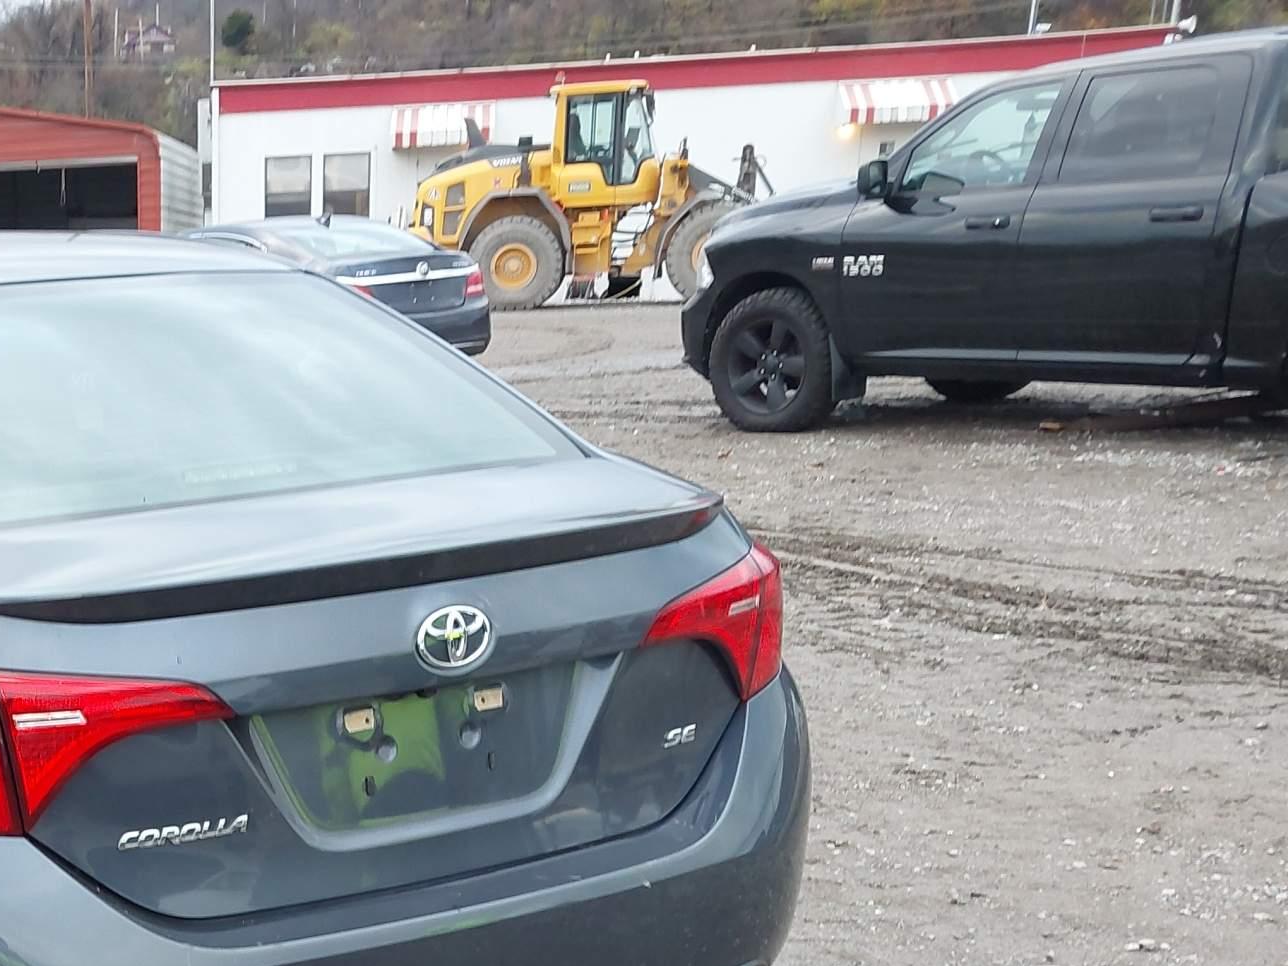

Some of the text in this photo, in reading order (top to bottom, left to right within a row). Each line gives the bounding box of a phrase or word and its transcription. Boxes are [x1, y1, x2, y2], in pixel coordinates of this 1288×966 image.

[842, 264, 884, 277] 1500
[843, 255, 885, 267] RAM
[663, 723, 697, 749] SE
[117, 814, 249, 850] COROLLA
